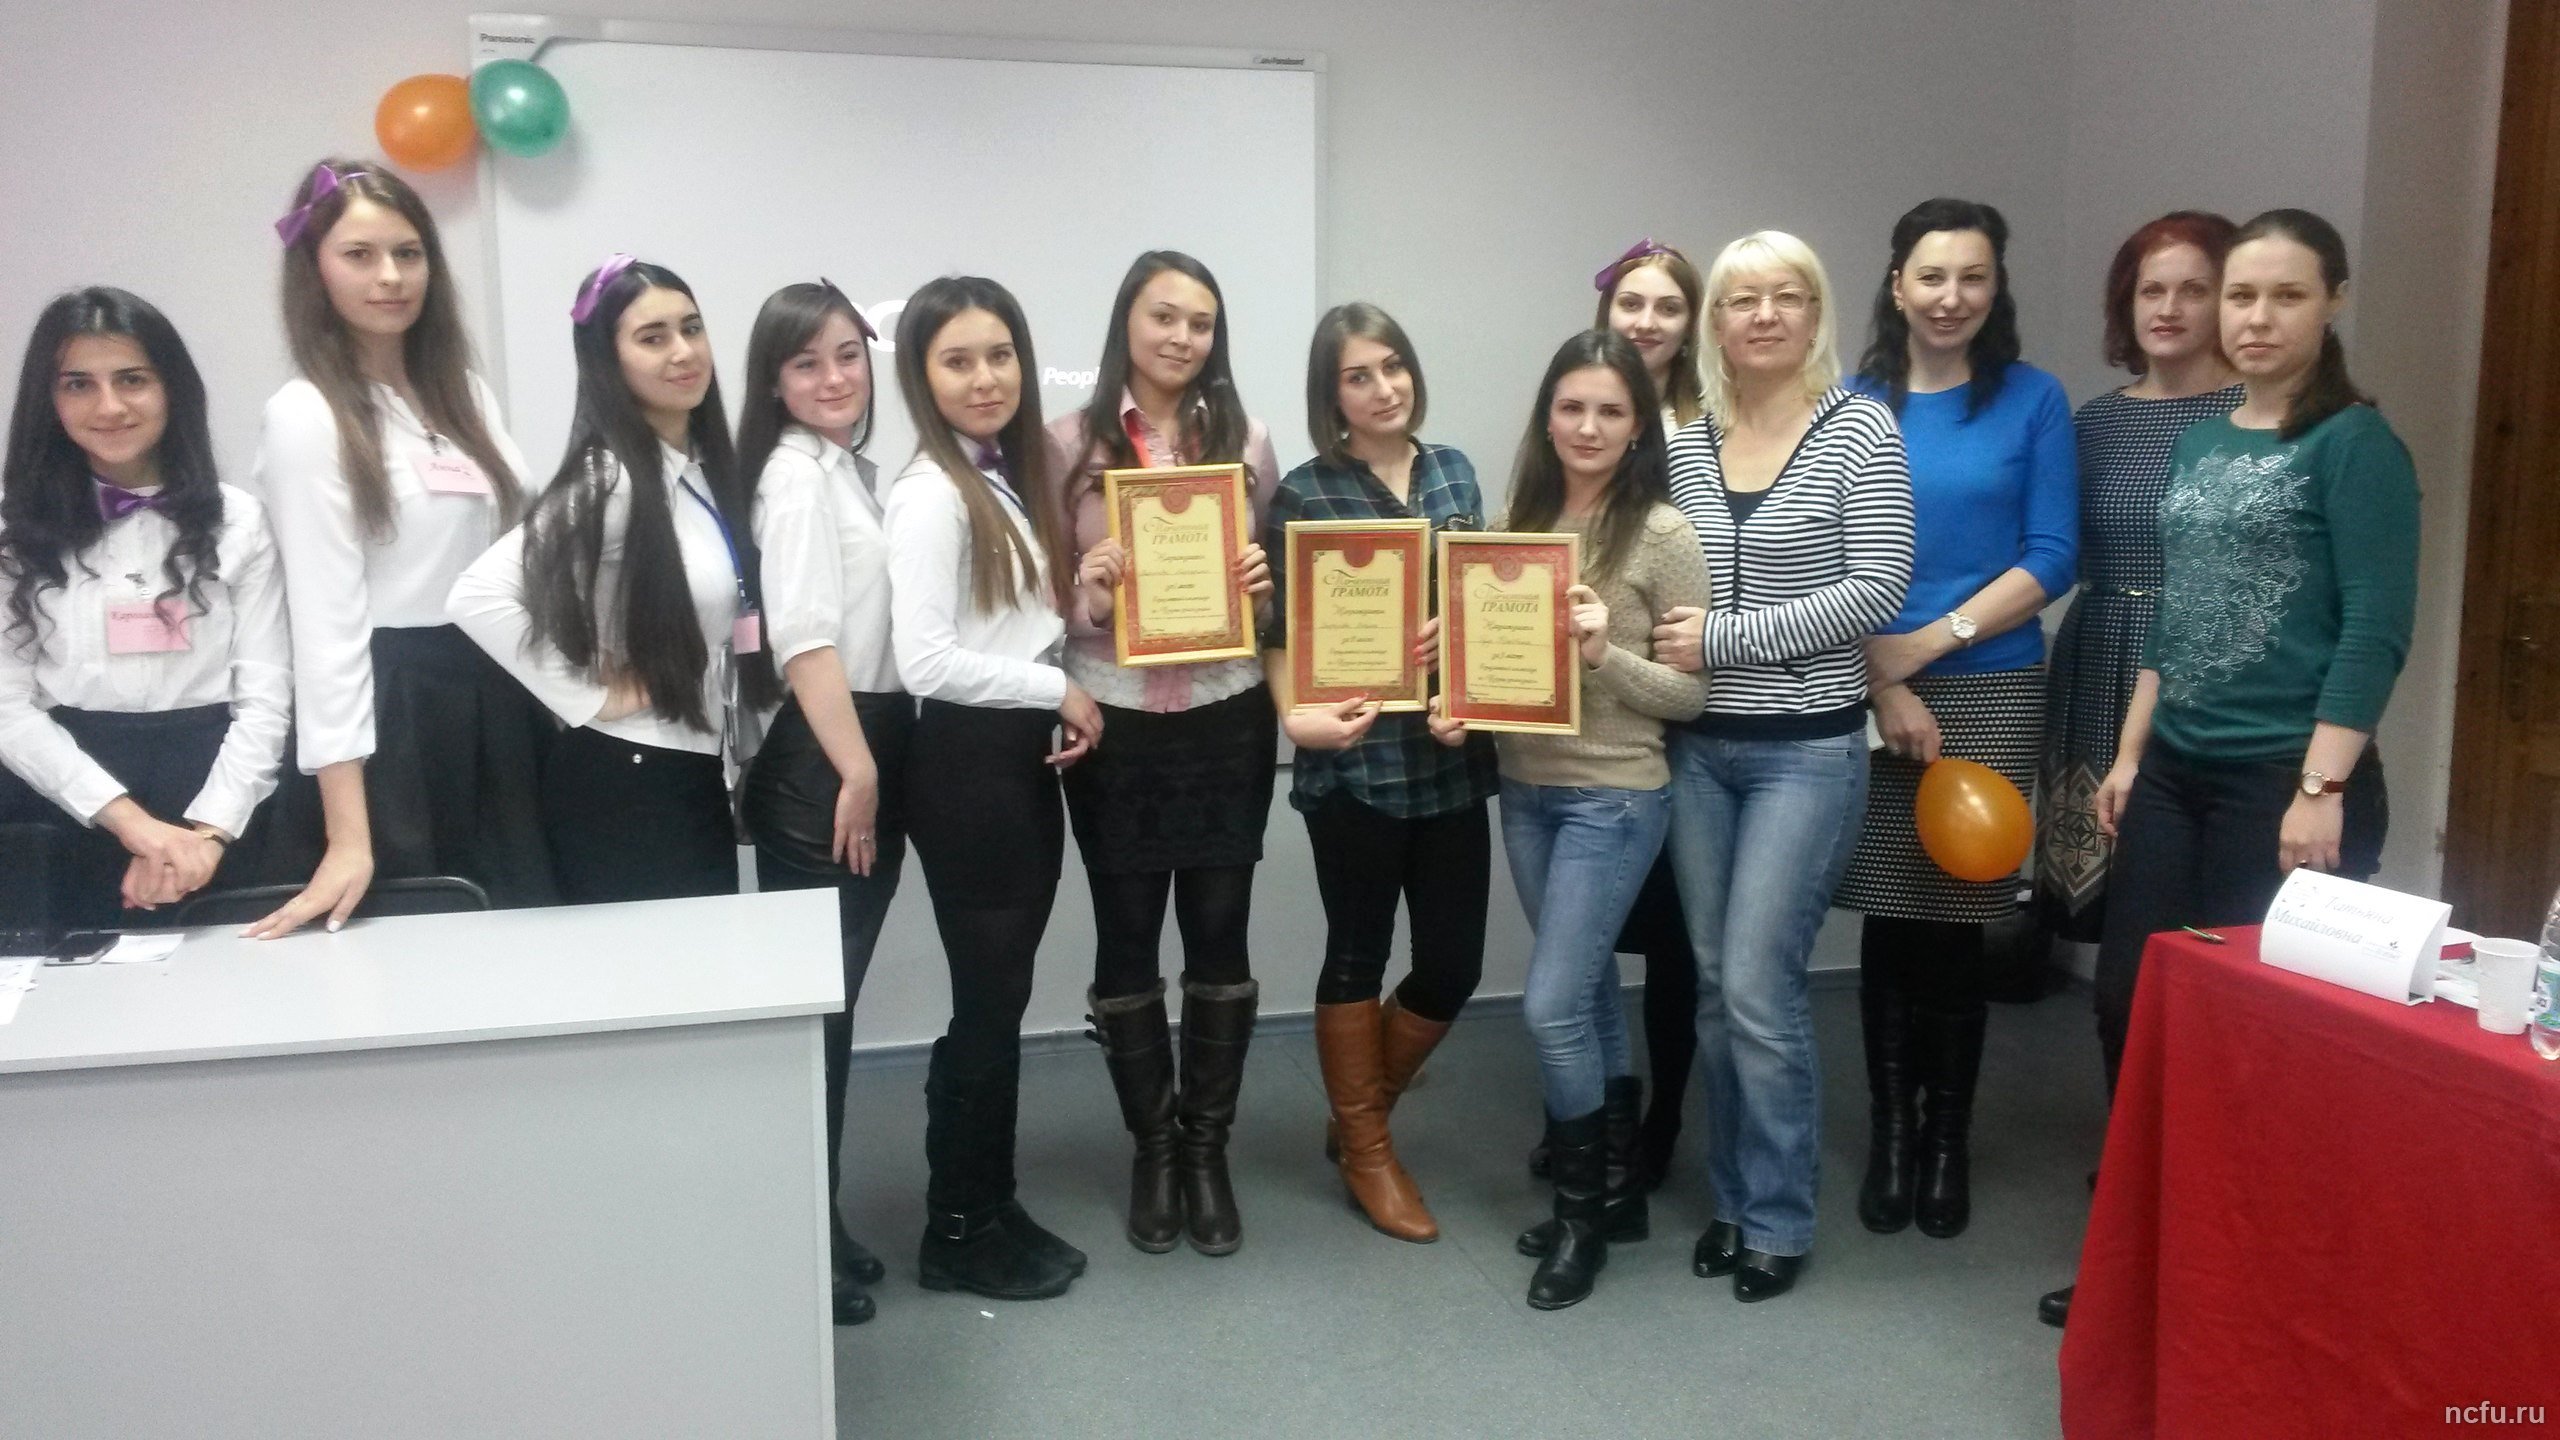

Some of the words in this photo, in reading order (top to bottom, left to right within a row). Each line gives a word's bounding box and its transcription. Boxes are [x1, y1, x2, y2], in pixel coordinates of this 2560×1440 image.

[480, 33, 536, 44] Panasonic
[1152, 533, 1208, 545] ГРАМОТА
[1330, 587, 1389, 598] ГРАМОТА
[1480, 600, 1539, 613] ГРАМОТА
[2269, 907, 2364, 944] Михайловна
